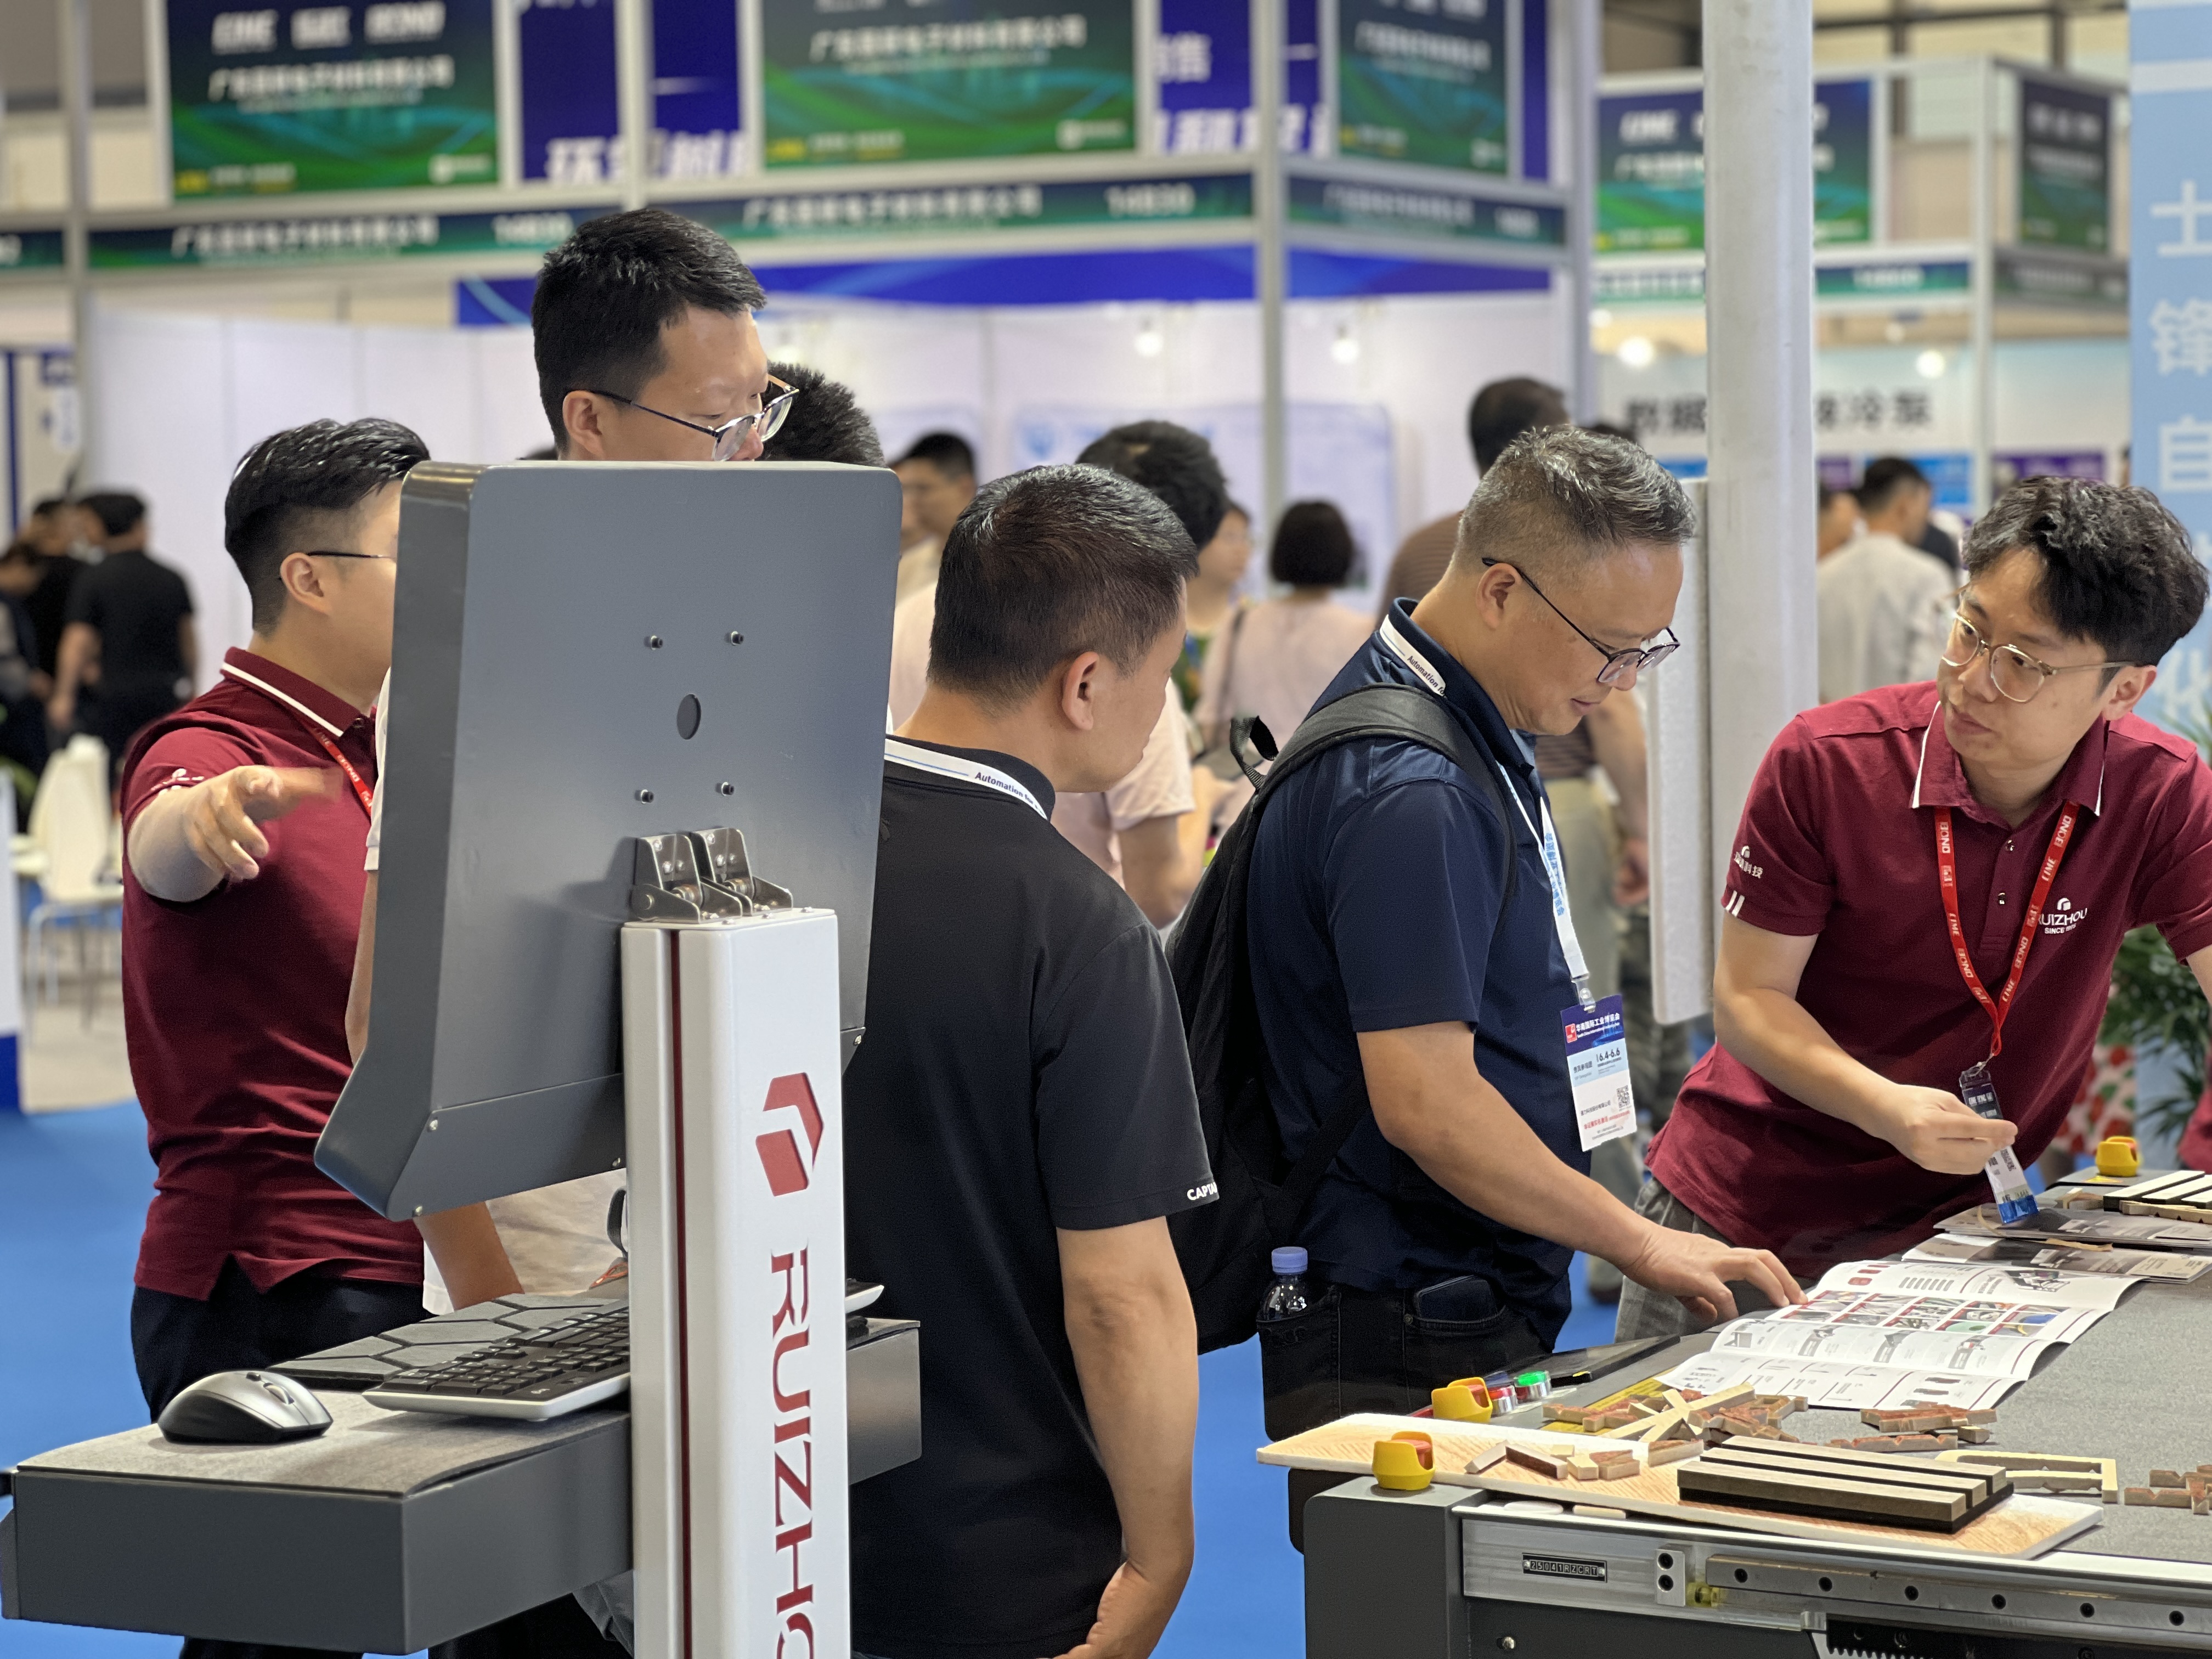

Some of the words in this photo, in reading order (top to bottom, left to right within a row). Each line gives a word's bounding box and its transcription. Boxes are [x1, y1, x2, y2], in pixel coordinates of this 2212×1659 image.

[1407, 655, 1438, 688] Automation
[975, 772, 1023, 797] Automation
[1940, 821, 1951, 854] BOND
[1957, 948, 1974, 978] BOND
[2014, 936, 2029, 969] BOND
[2054, 815, 2073, 848] BOND
[1599, 1047, 1620, 1062] 6.4-6.6
[1531, 1561, 1598, 1576] 25041RZCRT
